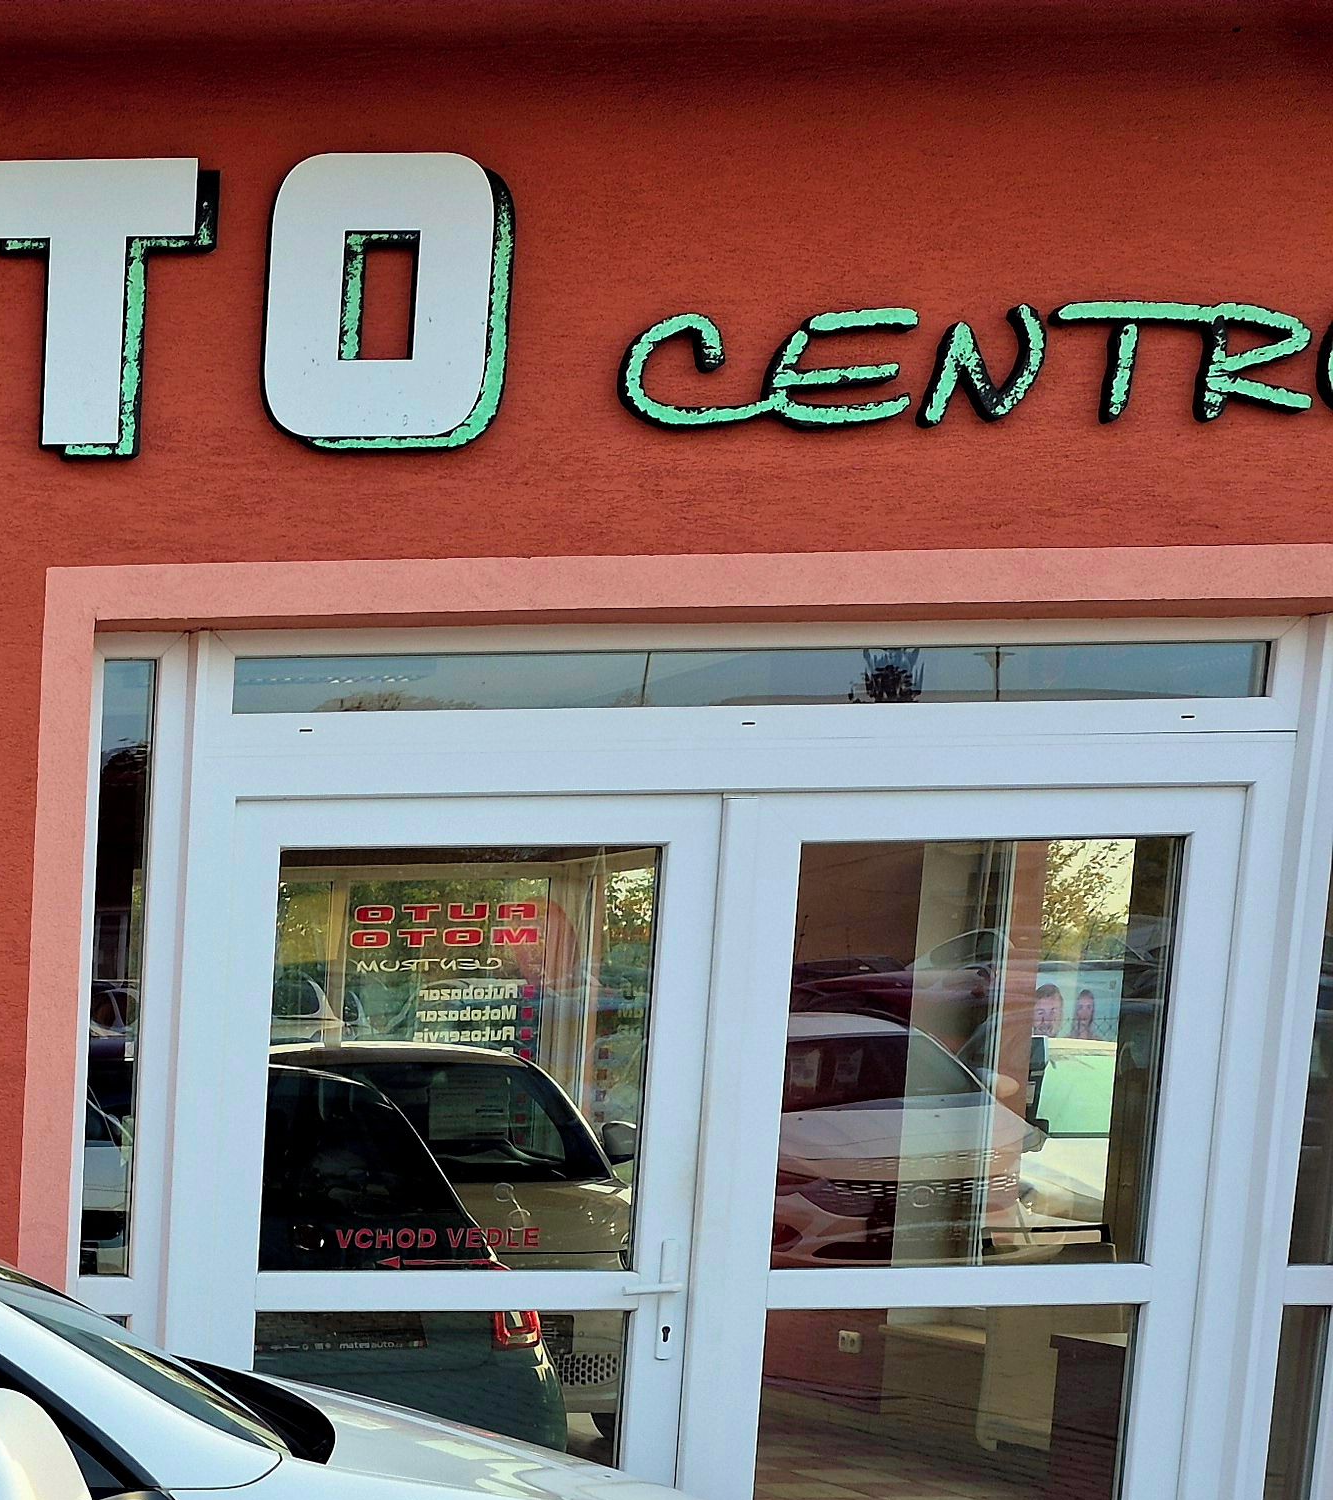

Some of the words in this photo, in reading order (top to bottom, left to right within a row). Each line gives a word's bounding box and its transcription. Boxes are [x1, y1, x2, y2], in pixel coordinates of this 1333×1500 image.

[617, 300, 1333, 430] CENTR
[336, 1228, 437, 1249] VCHOD
[446, 1227, 541, 1248] VEDLE
